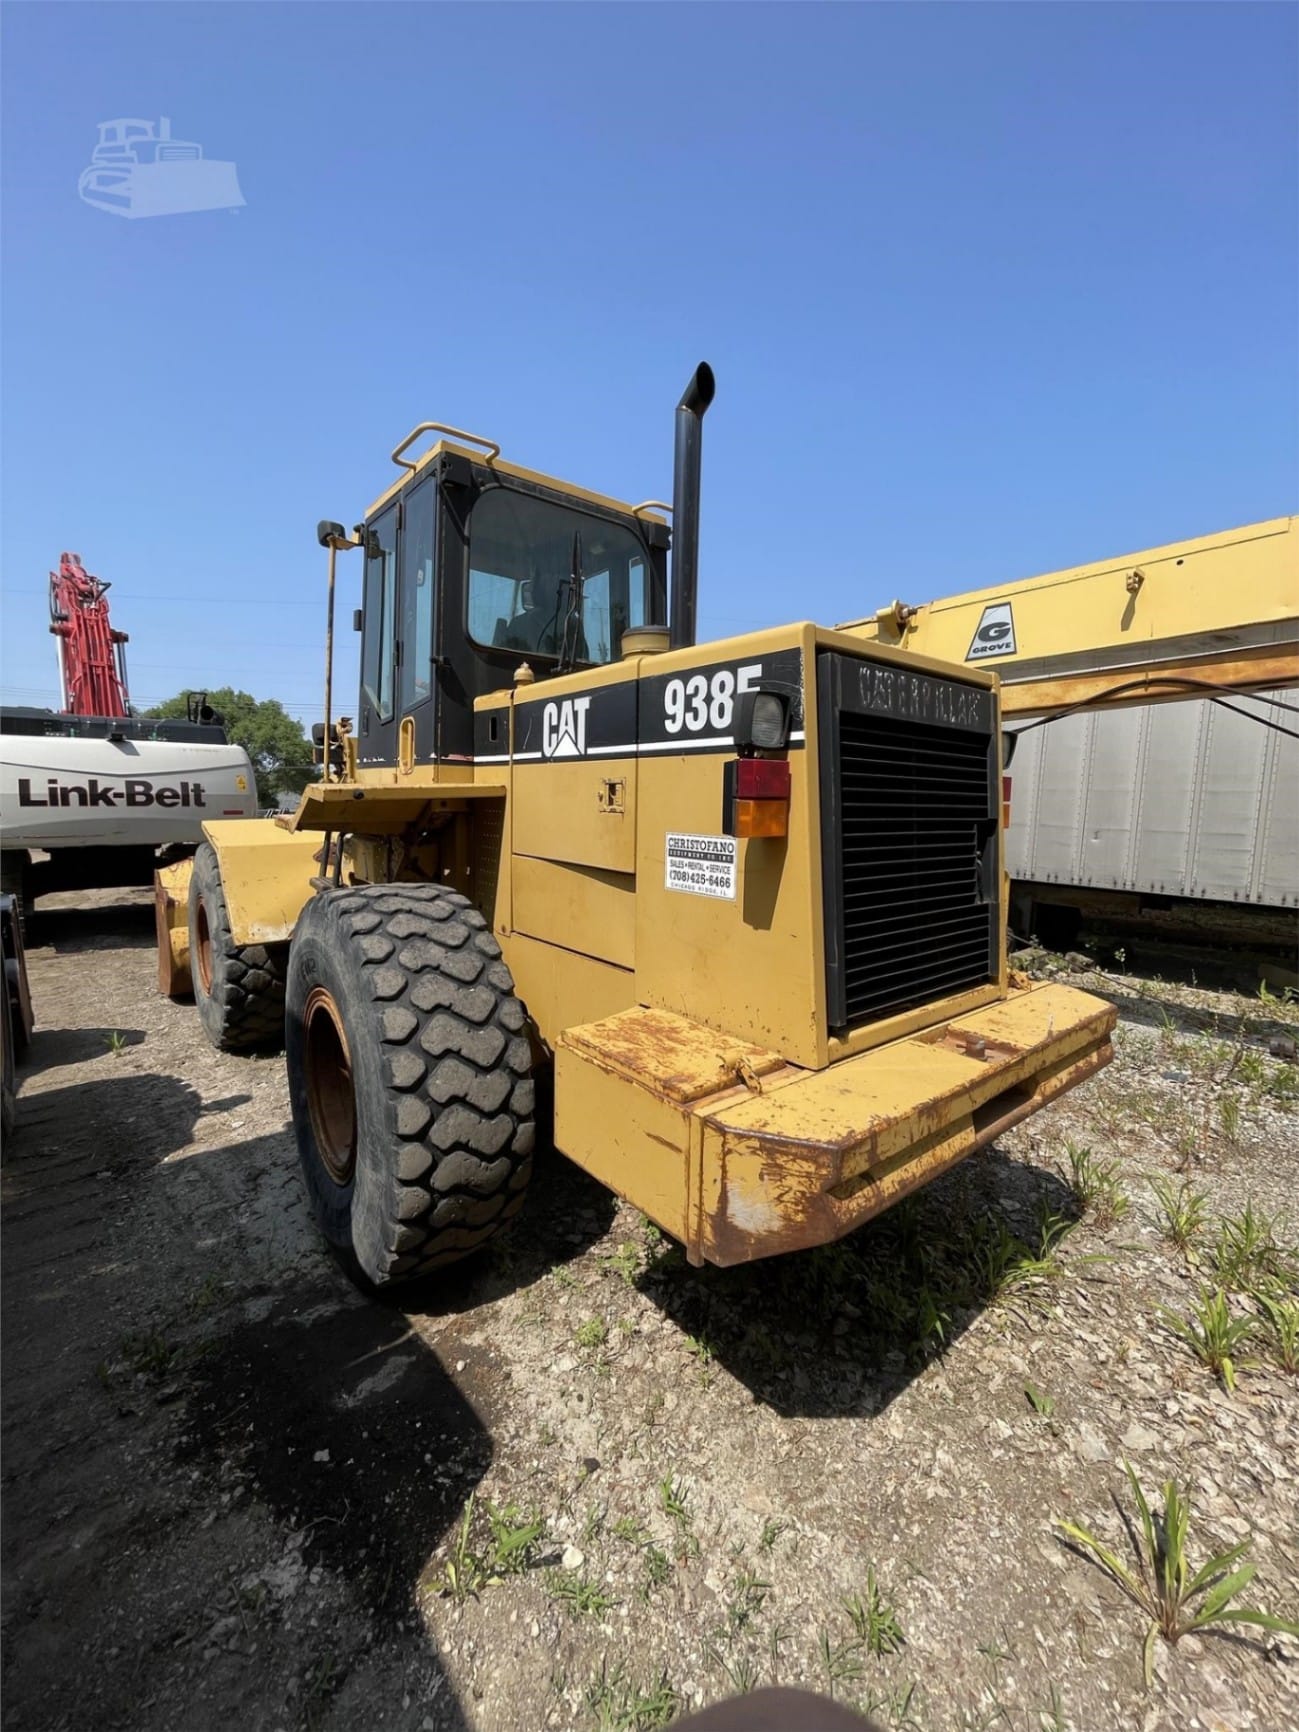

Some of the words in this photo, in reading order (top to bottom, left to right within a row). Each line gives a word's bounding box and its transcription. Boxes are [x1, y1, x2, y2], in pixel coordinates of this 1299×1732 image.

[972, 642, 1012, 654] GROVE
[542, 696, 592, 757] CAT
[18, 778, 206, 808] Link-Belt
[668, 837, 735, 854] CHRISTOFANO
